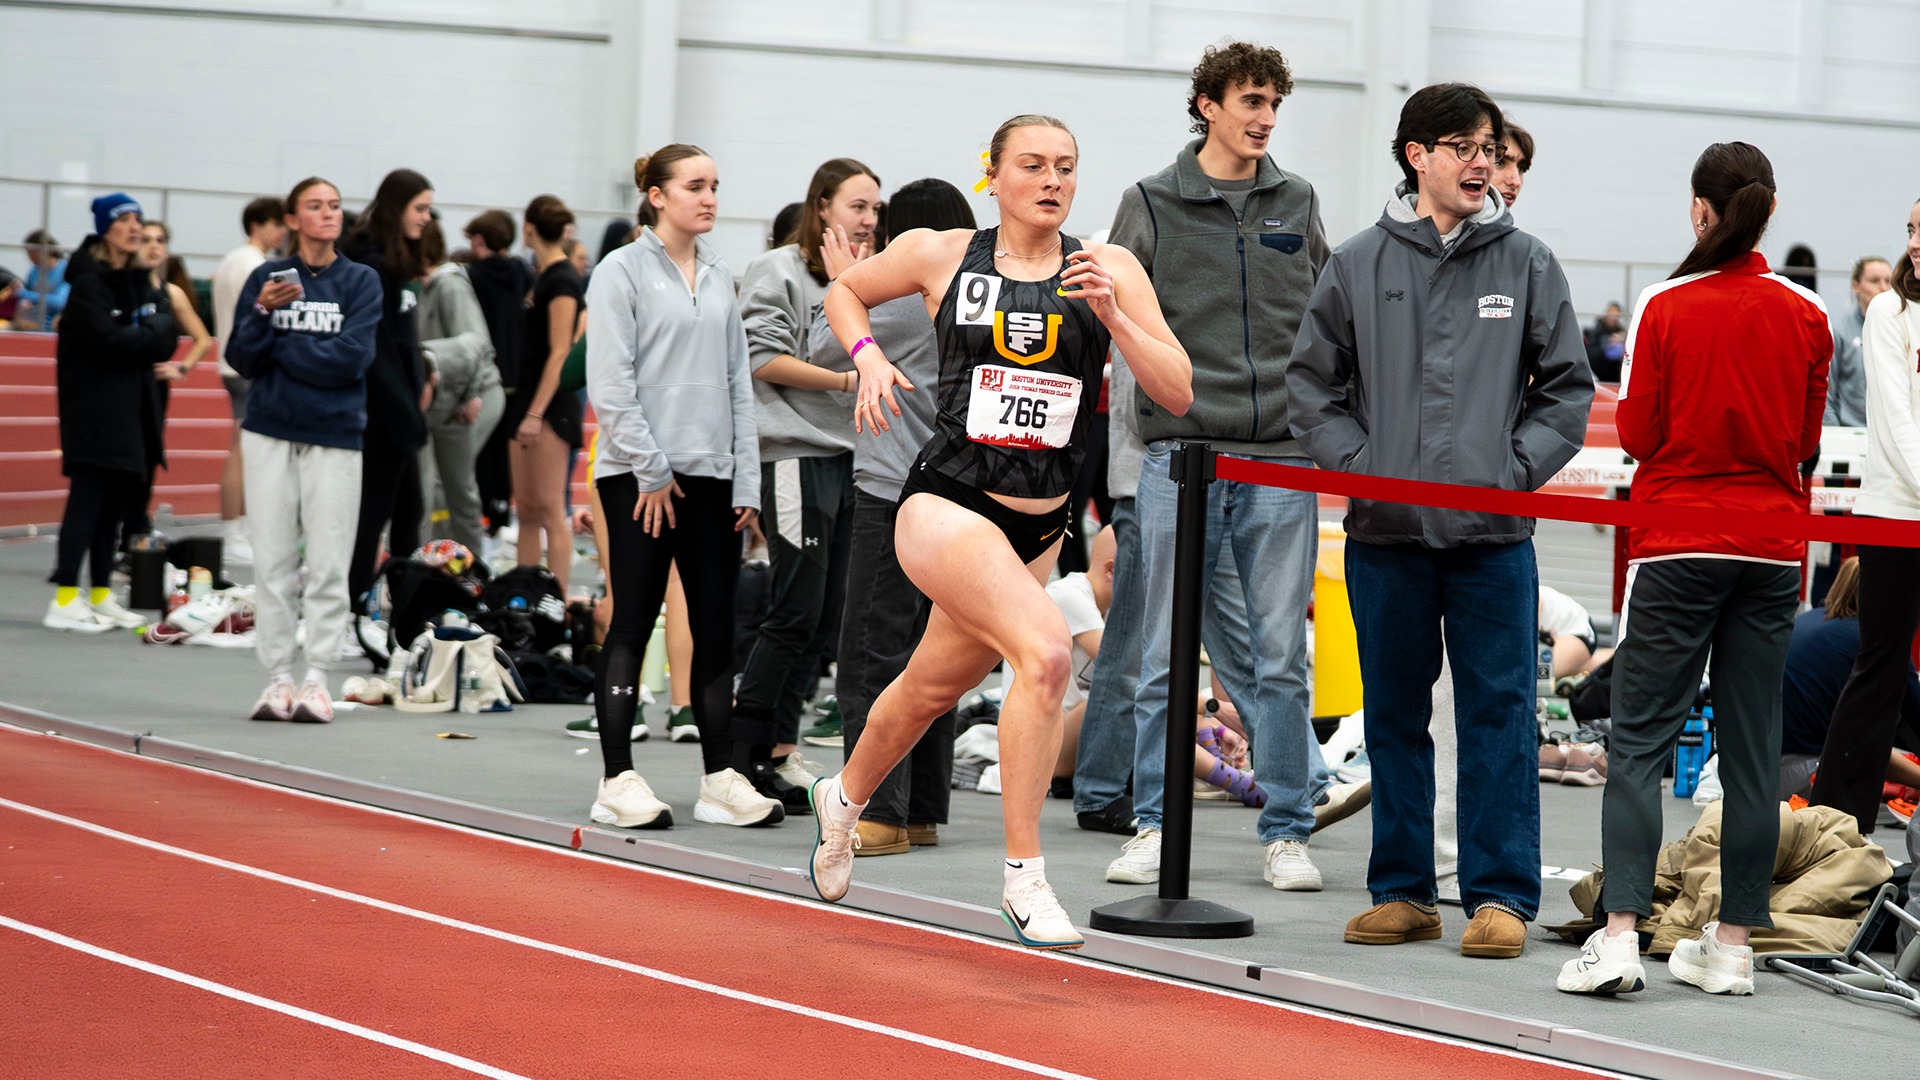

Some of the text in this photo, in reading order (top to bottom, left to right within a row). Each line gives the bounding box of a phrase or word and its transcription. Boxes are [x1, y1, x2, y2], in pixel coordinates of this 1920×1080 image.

[965, 276, 990, 321] 9
[1478, 294, 1514, 309] BOSTON
[291, 301, 340, 312] FLORIDA
[1012, 375, 1073, 389] BOSTON UNIVERSITY
[999, 395, 1048, 429] 766
